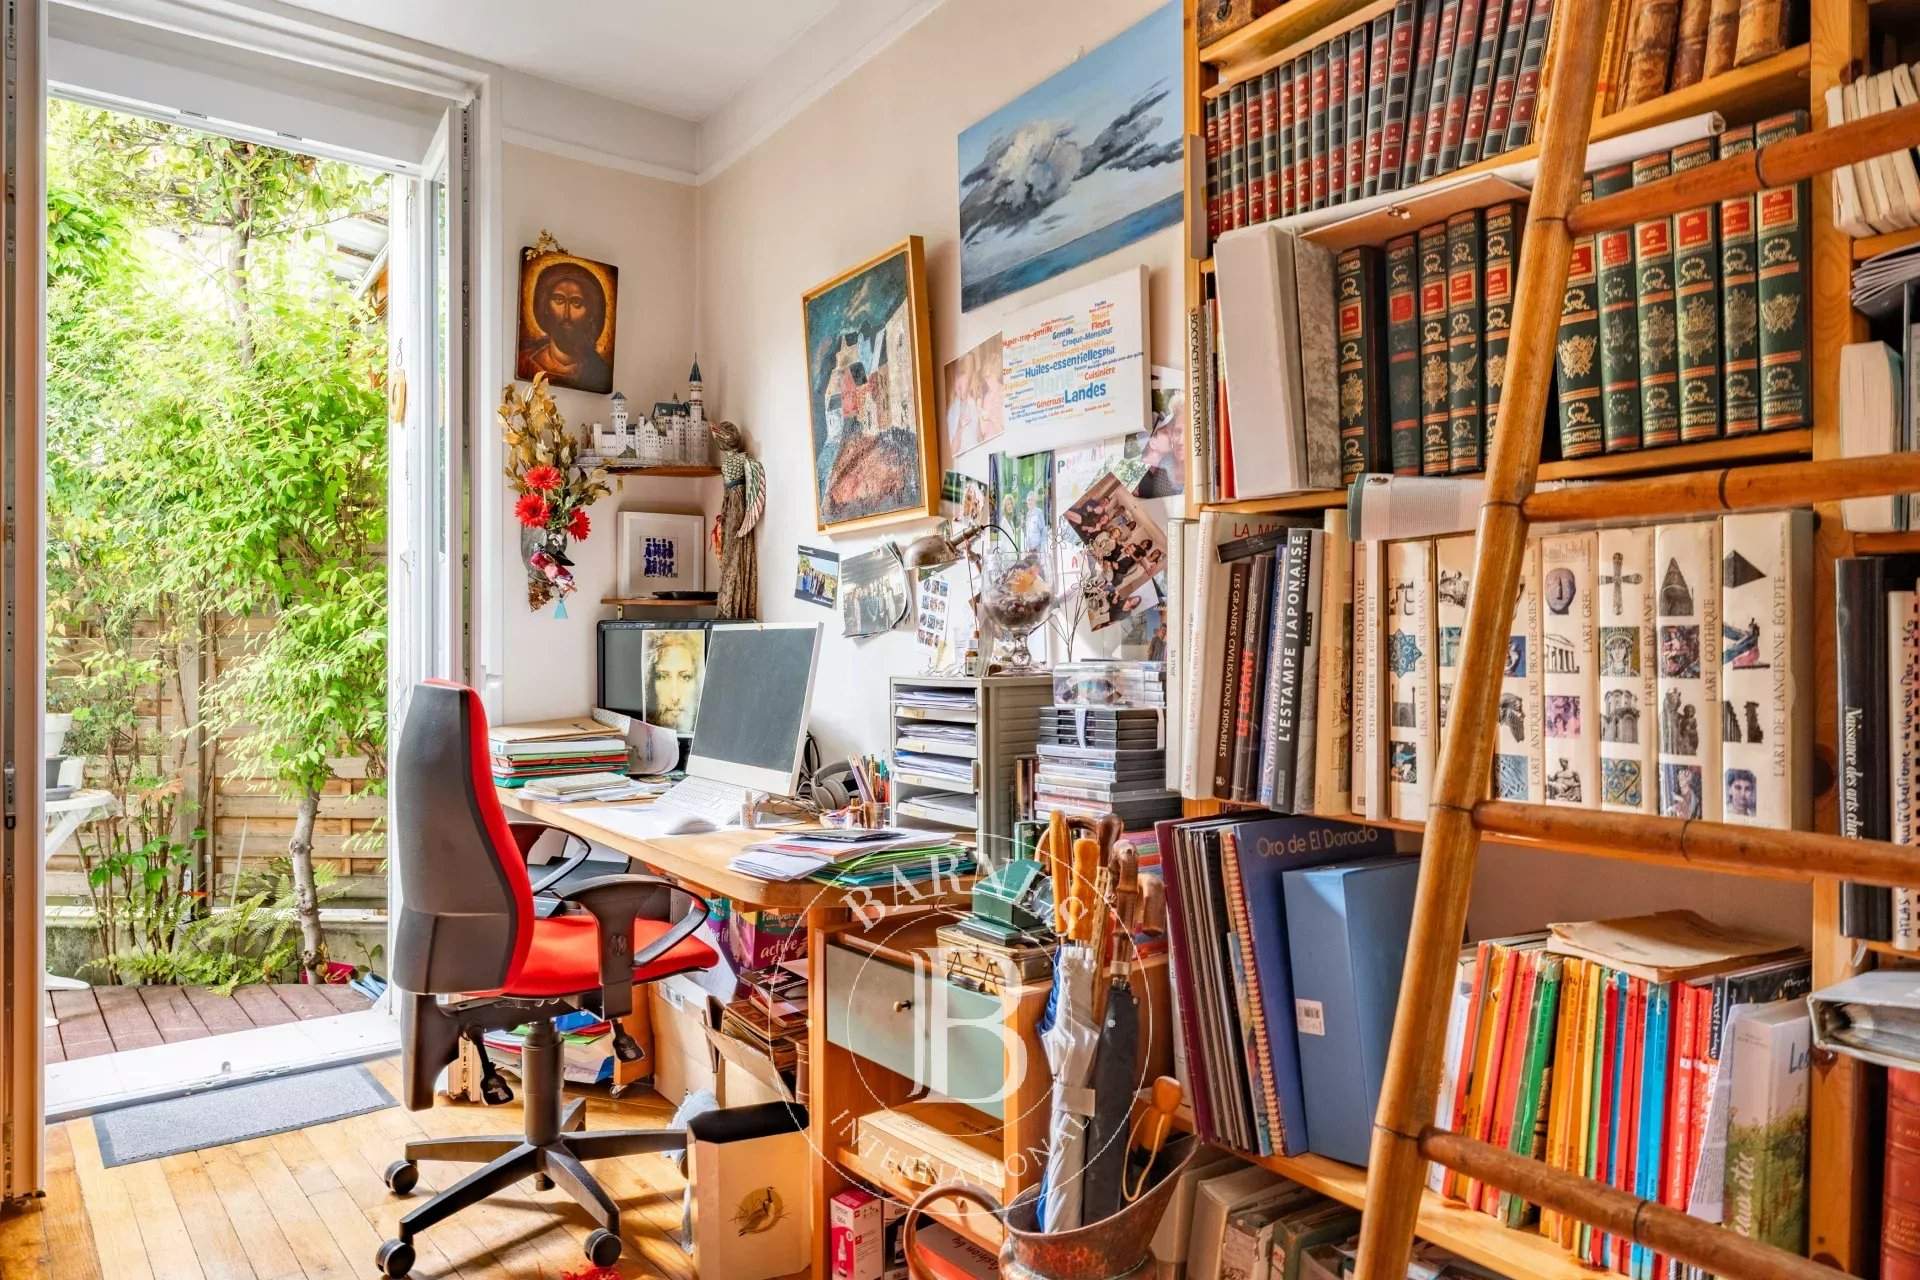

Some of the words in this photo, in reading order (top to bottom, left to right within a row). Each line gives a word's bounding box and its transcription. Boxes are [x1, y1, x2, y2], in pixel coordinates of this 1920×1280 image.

[1091, 318, 1111, 330] Fleurs
[1025, 349, 1103, 379] Huiles-essentielles
[1084, 365, 1116, 380] Cuisinière
[1064, 381, 1106, 404] Landes
[1191, 385, 1202, 457] DECAMERON
[1233, 523, 1250, 538] LA
[1232, 573, 1241, 588] LES
[1229, 589, 1241, 636] GRANDES
[1355, 579, 1365, 643] MOLDAVIE
[1581, 588, 1592, 618] GREC
[1770, 575, 1786, 626] ÉGYPTE
[1528, 590, 1539, 674] PROCHE-ORIENT
[1643, 593, 1654, 646] BYZANCE
[1704, 598, 1718, 663] GOTHIQUE
[1277, 647, 1296, 742] L'ESTAMPE
[1287, 534, 1304, 640] JAPONAISE
[1582, 623, 1593, 654] L'ART
[1355, 648, 1365, 664] DE
[1643, 651, 1654, 669] DE
[1223, 638, 1237, 707] CIVILISATIONS
[1704, 669, 1717, 702] L'ART
[1773, 631, 1785, 713] L'ANCIENNE
[1528, 680, 1539, 696] DU
[1643, 676, 1655, 707] L'ART
[1218, 708, 1230, 758] DISPARUES
[1529, 700, 1541, 750] ANTIQUE
[1773, 718, 1785, 735] DE
[1845, 706, 1864, 765] Naissance
[1529, 756, 1540, 786] L'ART
[1773, 743, 1785, 777] L'ART
[1846, 766, 1864, 787] des
[1846, 788, 1860, 812] arts
[1257, 837, 1285, 857] Oro
[1287, 833, 1306, 855] de
[1309, 831, 1322, 851] El
[1325, 827, 1379, 851] Dorado
[1898, 899, 1912, 937] ATLAS
[760, 938, 798, 959] active
[1730, 1150, 1755, 1189] étés
